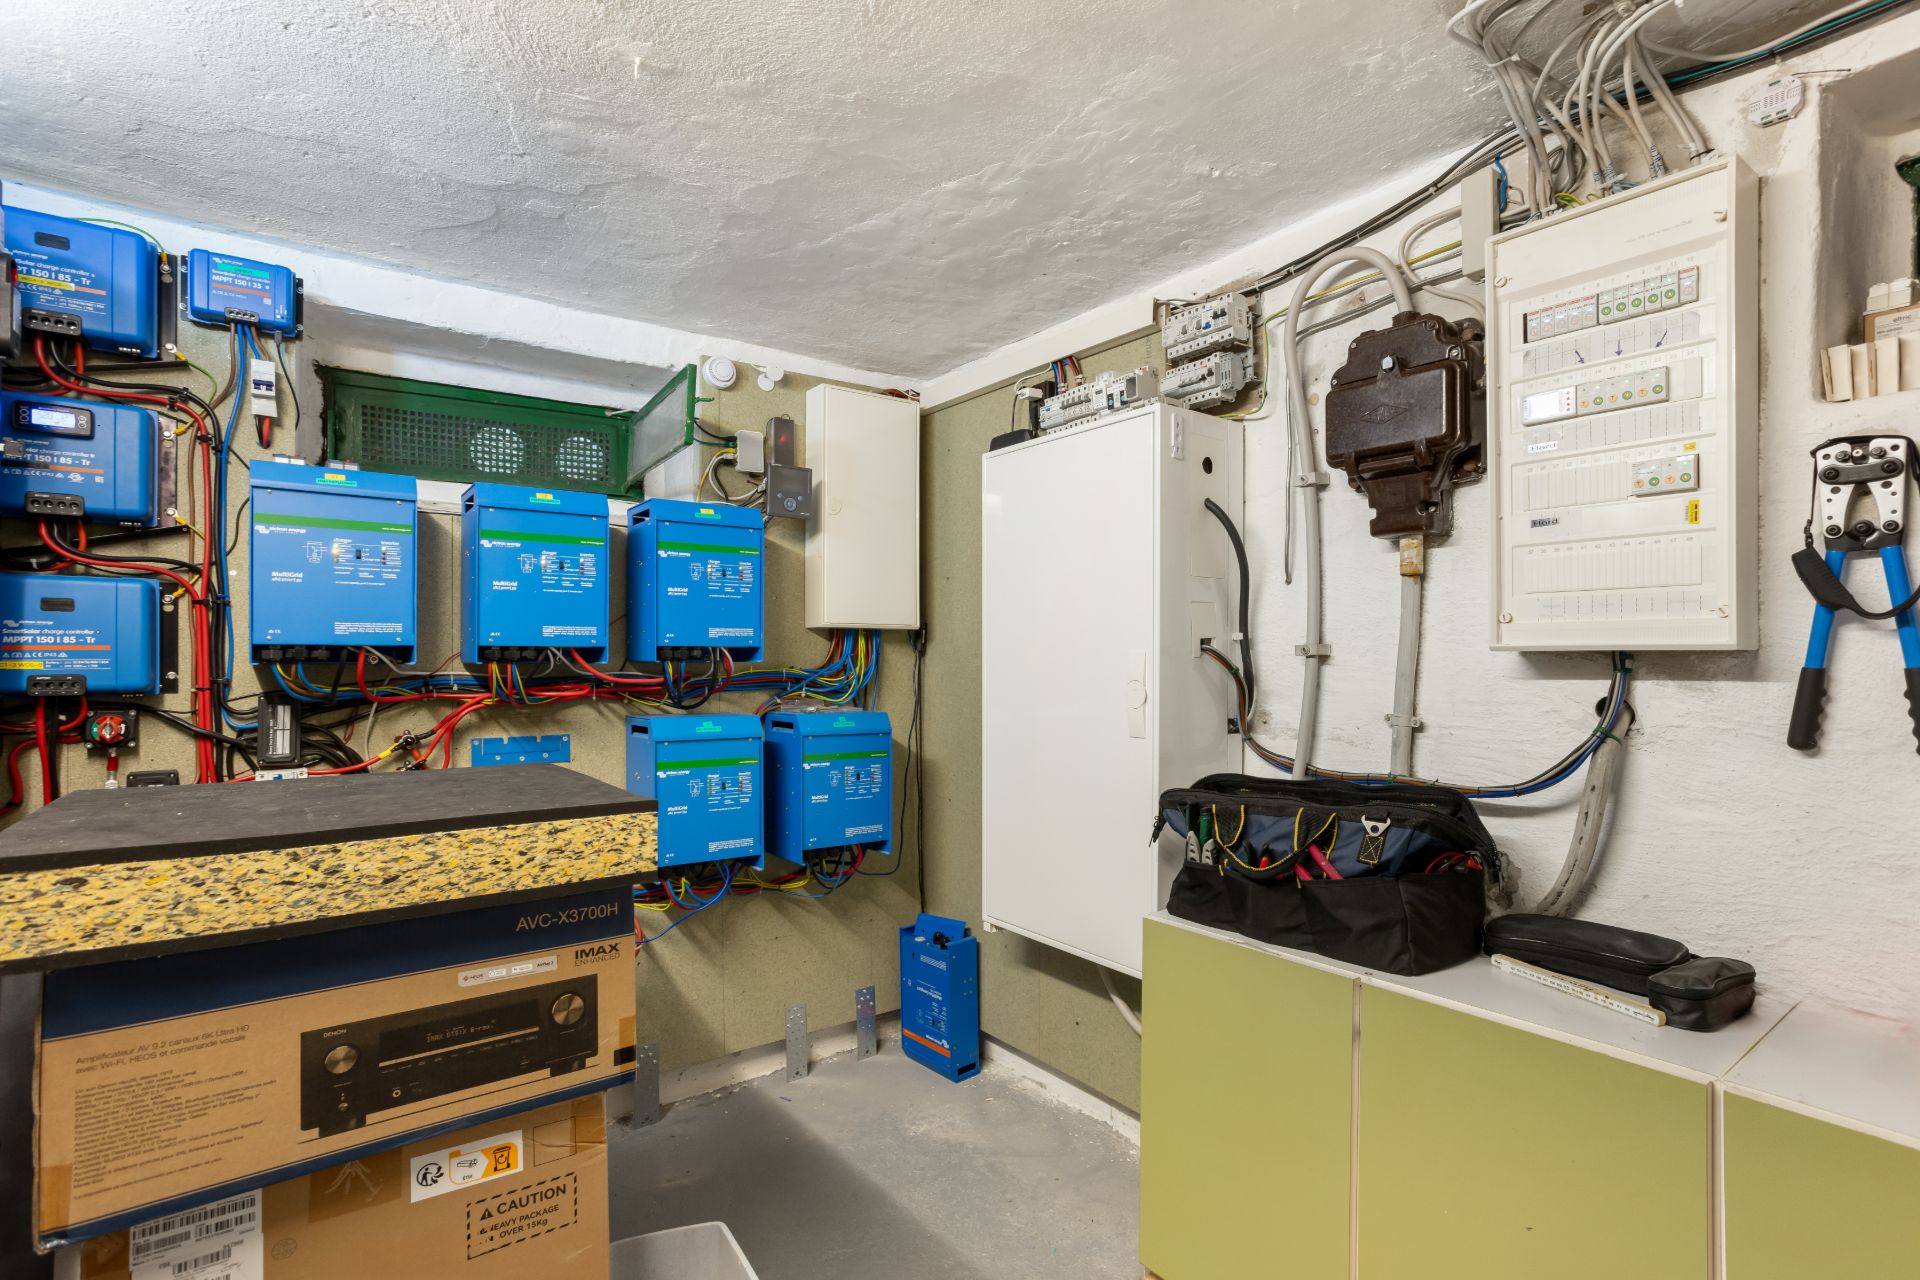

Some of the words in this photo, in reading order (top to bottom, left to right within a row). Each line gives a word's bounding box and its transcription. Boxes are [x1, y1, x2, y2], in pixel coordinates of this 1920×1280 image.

[31, 268, 49, 278] 150
[57, 273, 72, 282] 85
[35, 454, 52, 463] 150
[60, 457, 72, 465] 85
[2, 636, 34, 644] MPPT
[36, 636, 55, 644] 150
[62, 636, 76, 644] 85
[85, 636, 96, 644] Tr
[515, 902, 618, 932] AVC-X3700H
[575, 943, 620, 959] IMAX
[575, 953, 620, 967] ENHANCED
[137, 1044, 151, 1052] AV
[236, 1024, 250, 1032] HD
[129, 1052, 157, 1063] HEOS
[170, 1041, 218, 1055] commande
[220, 1035, 246, 1045] vocale
[497, 1183, 567, 1215] CAUTION
[520, 1204, 560, 1222] PACKAGE
[500, 1226, 524, 1239] OVER
[527, 1219, 548, 1230] 15Kg
